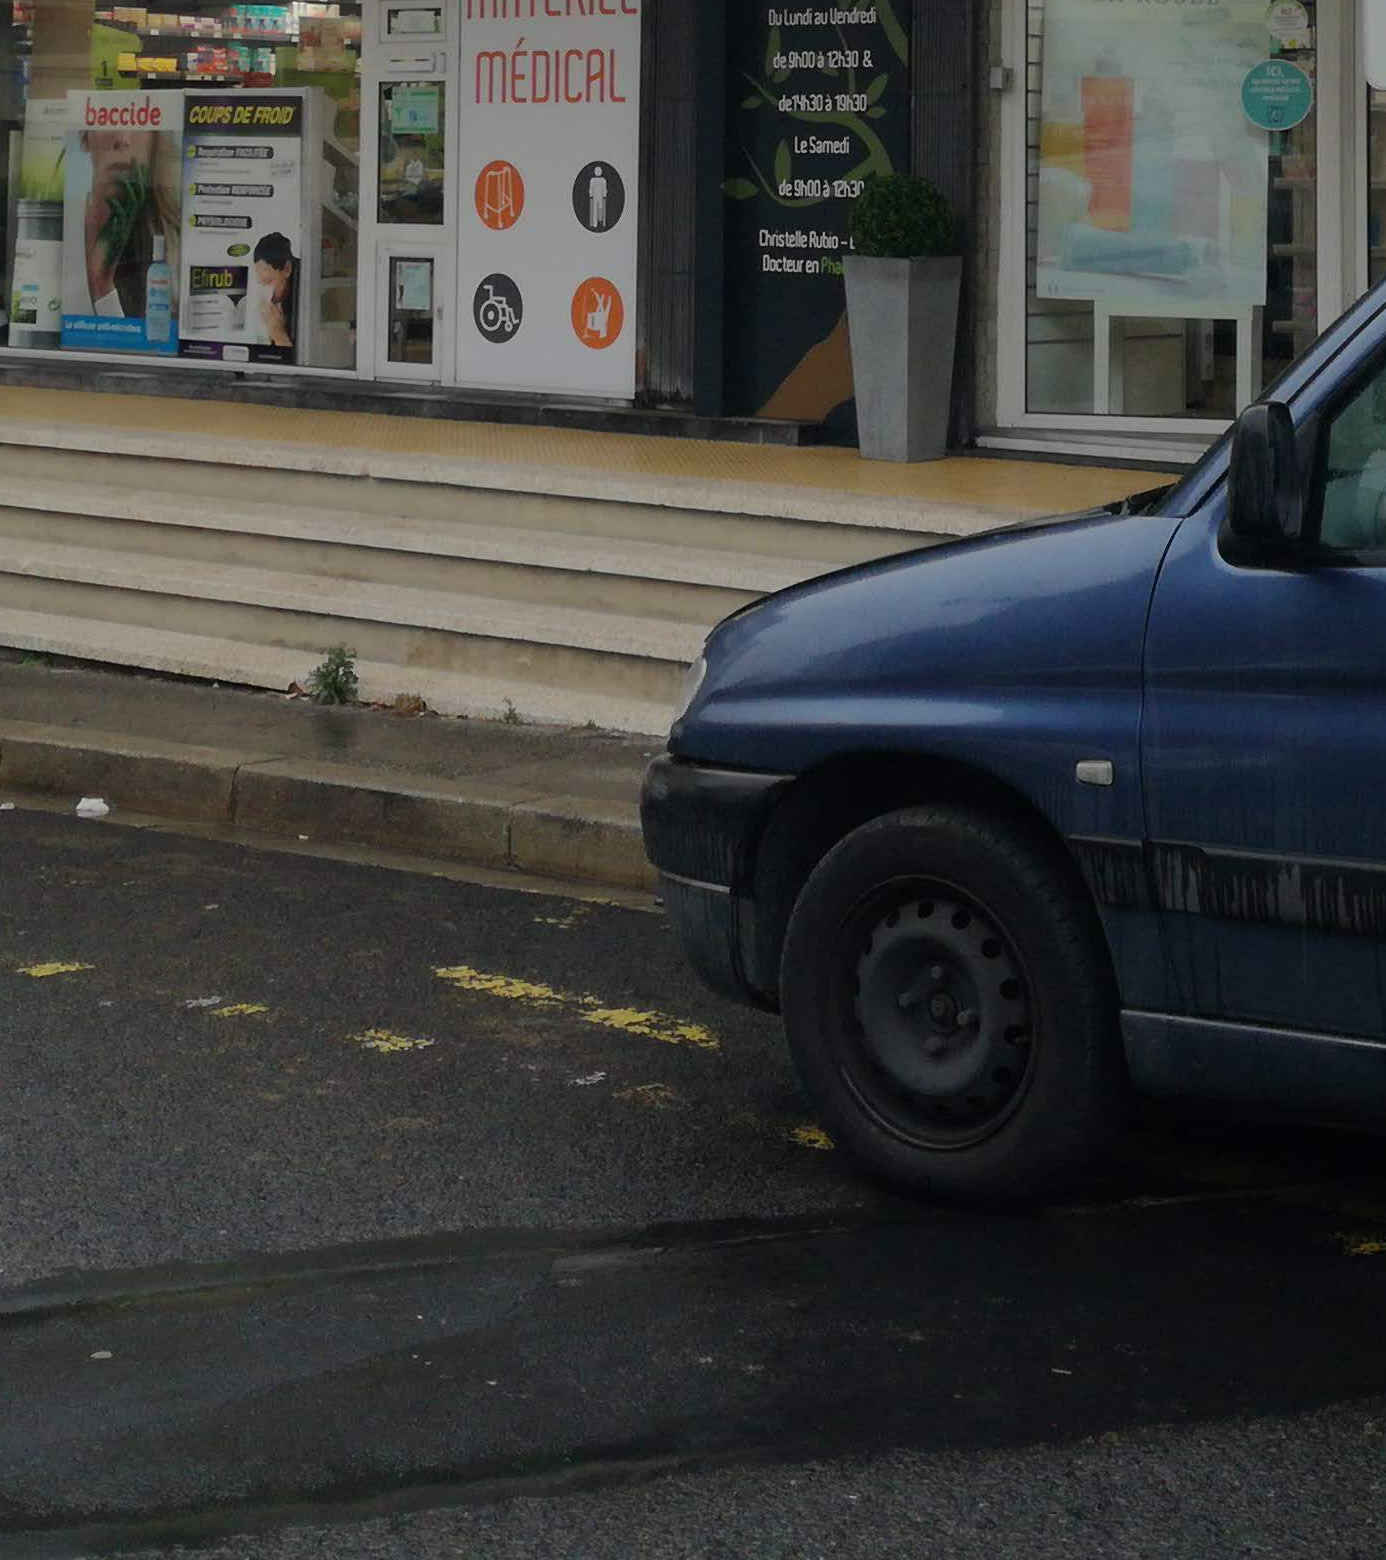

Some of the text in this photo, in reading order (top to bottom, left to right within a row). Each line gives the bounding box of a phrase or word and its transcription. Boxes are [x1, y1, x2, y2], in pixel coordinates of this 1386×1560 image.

[768, 7, 877, 26] Du Lundi au Vendredi
[773, 52, 787, 69] de
[789, 51, 816, 69] 9h00
[827, 50, 859, 69] 12h30
[862, 50, 874, 68] &
[475, 37, 627, 104] MÉDICAL
[85, 96, 162, 127] baccide
[778, 94, 792, 112] de
[792, 94, 823, 112] 14h30
[835, 93, 867, 112] 19h30
[189, 105, 294, 125] COUPS DE FROID
[794, 135, 850, 154] Le Samedi
[778, 179, 792, 197] de
[794, 179, 821, 197] 9h00
[759, 229, 807, 249] Christelle
[809, 230, 838, 249] Rubio
[762, 254, 803, 273] Docteur
[805, 260, 820, 273] en
